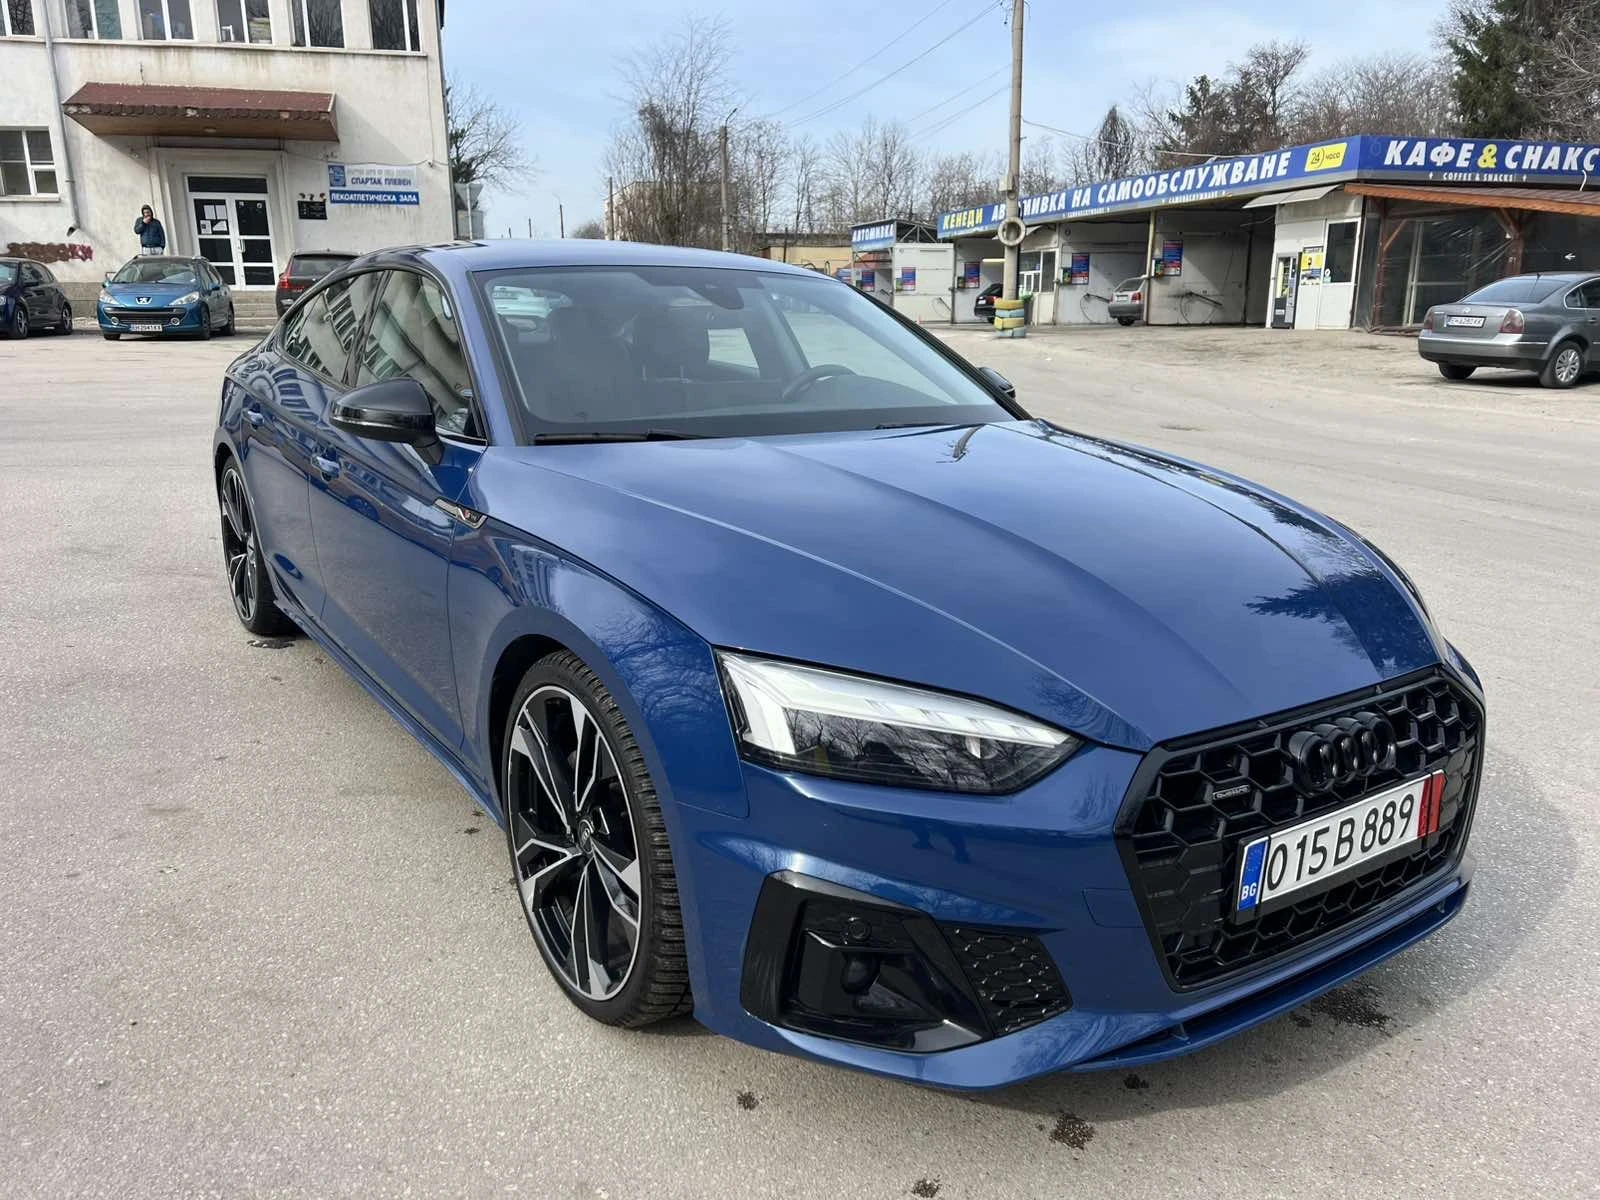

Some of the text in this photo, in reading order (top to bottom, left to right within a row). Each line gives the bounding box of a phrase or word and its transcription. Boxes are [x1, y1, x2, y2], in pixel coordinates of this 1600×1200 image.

[1384, 140, 1599, 171] КАФЕ & СНАКС
[351, 177, 412, 186] СПАРТАК ПЛЕВЕН
[1443, 172, 1472, 181] COFFEE
[1483, 173, 1513, 182] SNACKS
[331, 193, 418, 203] ЛЕКОАТЛЕТИЧЕСКА ЗАЛА
[943, 208, 983, 230] КЕНЕДИ
[1071, 189, 1091, 208] НА
[1098, 151, 1291, 204] САМООБСЛУЖВАНЕ
[852, 223, 895, 242] АВТОМИВКА
[1241, 882, 1257, 901] BG
